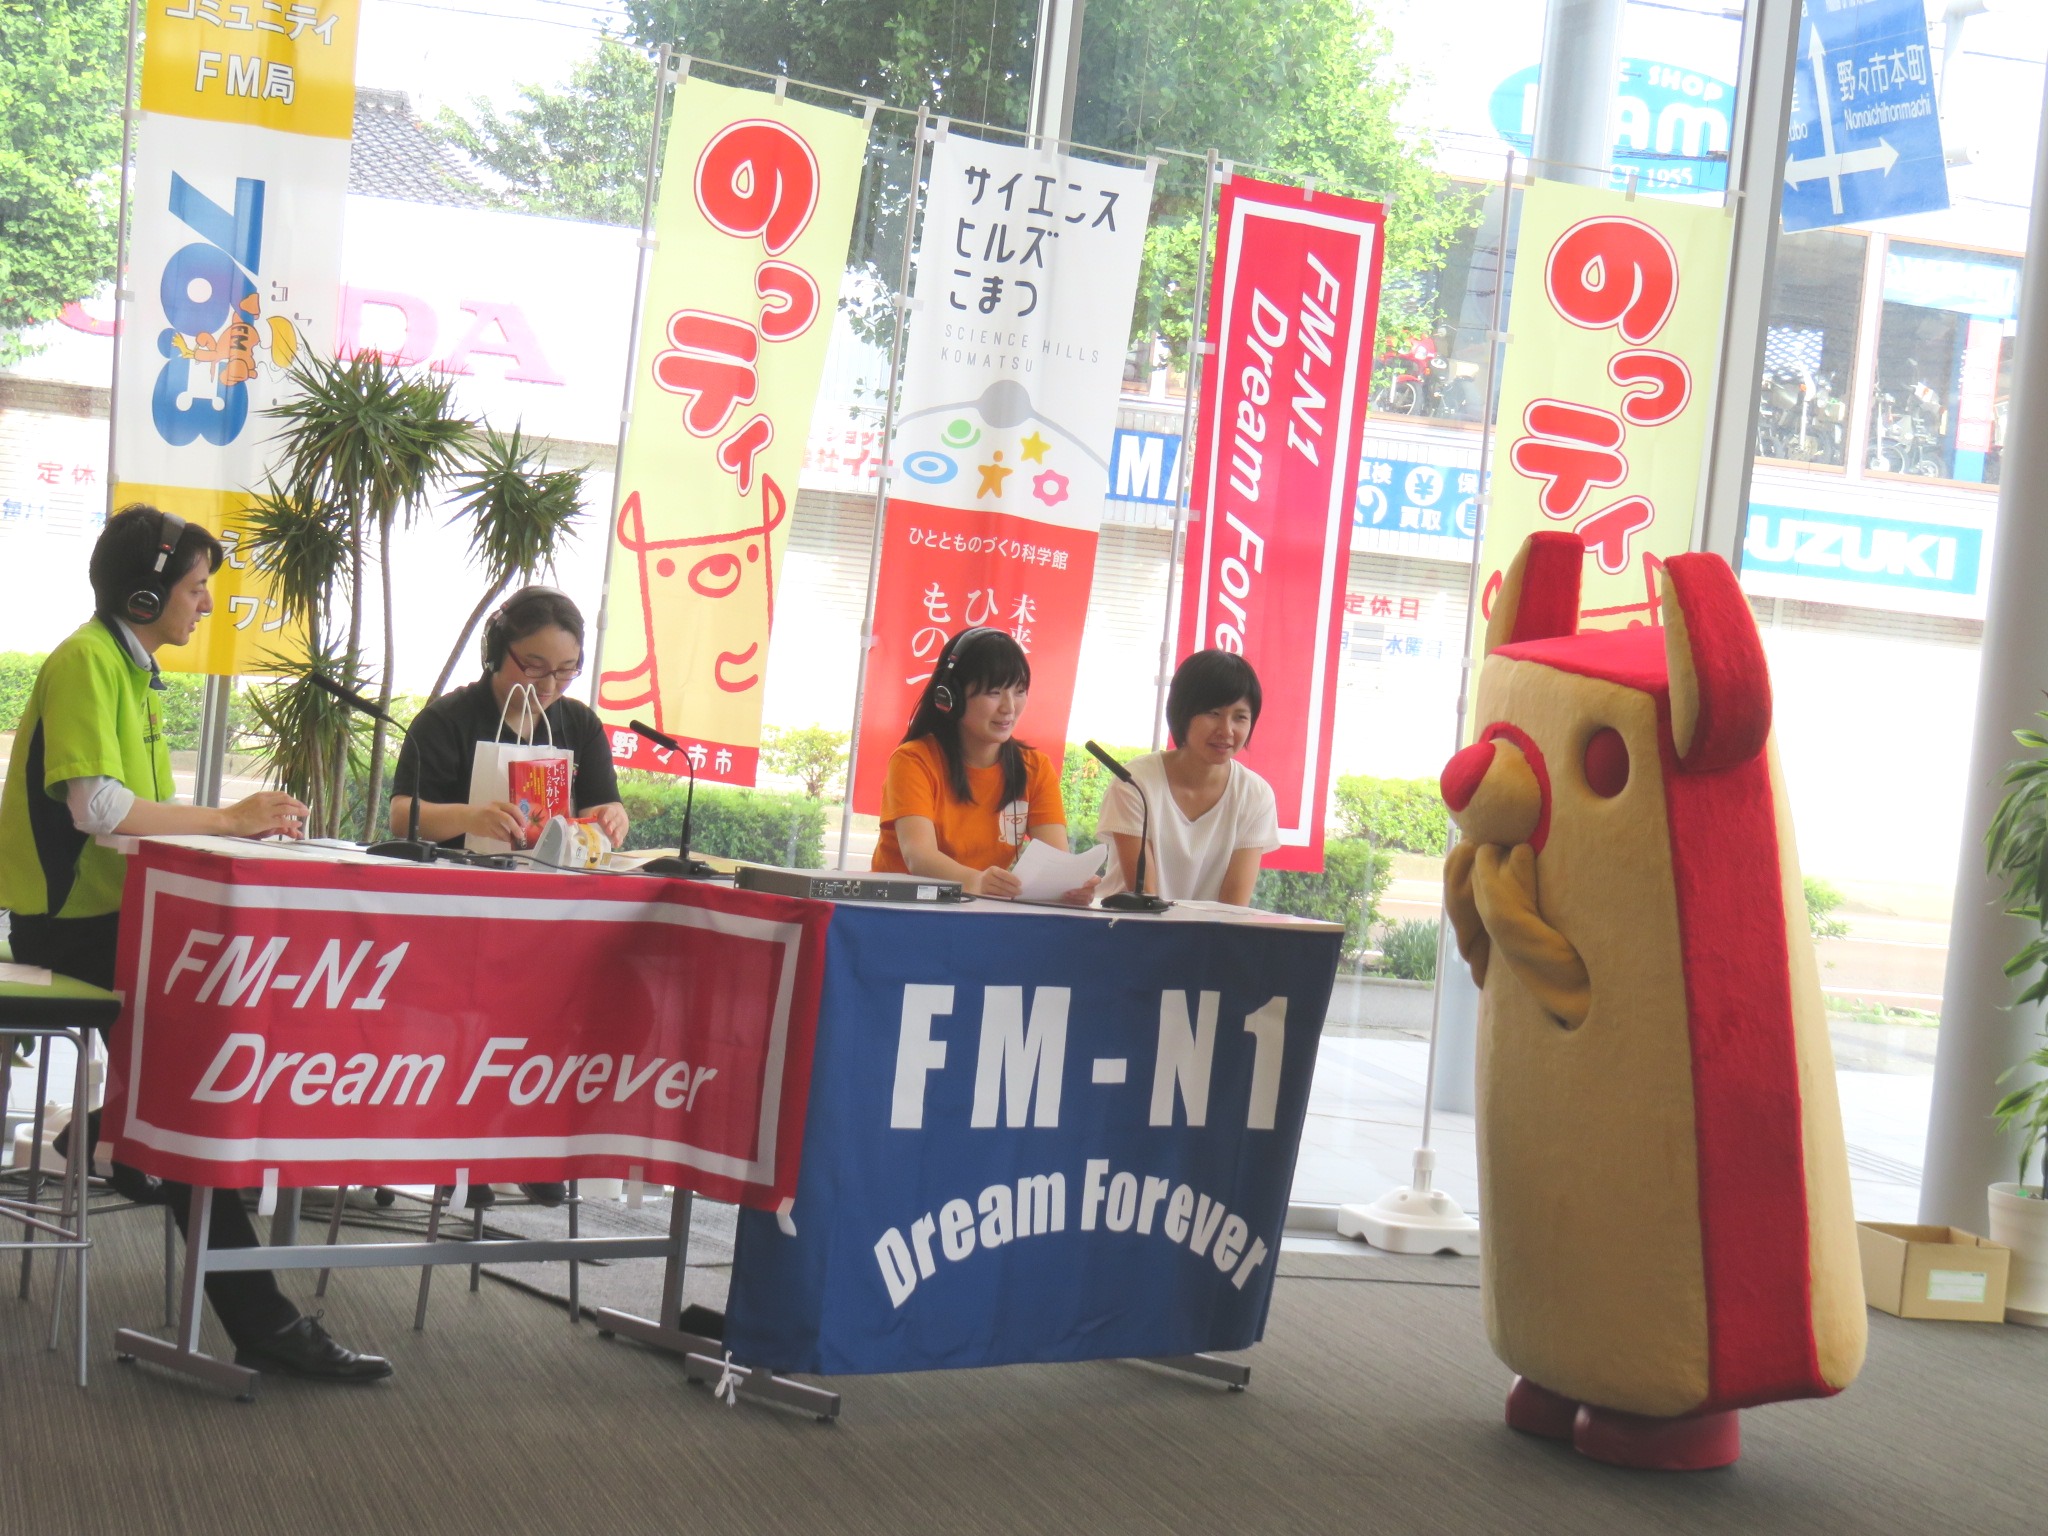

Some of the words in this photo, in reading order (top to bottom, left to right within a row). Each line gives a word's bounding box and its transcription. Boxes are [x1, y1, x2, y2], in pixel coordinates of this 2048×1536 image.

[166, 0, 339, 45] コミュニティ
[195, 50, 296, 105] FM局
[1648, 65, 1723, 101] SHOP
[1837, 44, 1927, 102] 野々市本町
[1844, 93, 1932, 131] Nonoichihonmachi
[964, 166, 1120, 232] サイエンス
[1646, 167, 1694, 188] 1955
[956, 217, 1060, 269] ヒルズ
[950, 269, 1039, 318] こまつ
[941, 346, 1033, 373] KOMATSU
[945, 324, 1029, 348] SCIENCE
[1042, 339, 1099, 364] HILLS
[1286, 251, 1340, 468] FM-N1
[1225, 287, 1289, 502] Dream
[909, 527, 1069, 571] ひととものづくり科学館
[1744, 514, 1957, 581] UZUKI
[164, 928, 410, 1011] FM-N1
[191, 1033, 446, 1107] Dream
[458, 1037, 717, 1112] Forever
[874, 1171, 1066, 1309] Dream
[1081, 1159, 1268, 1291] Forever
